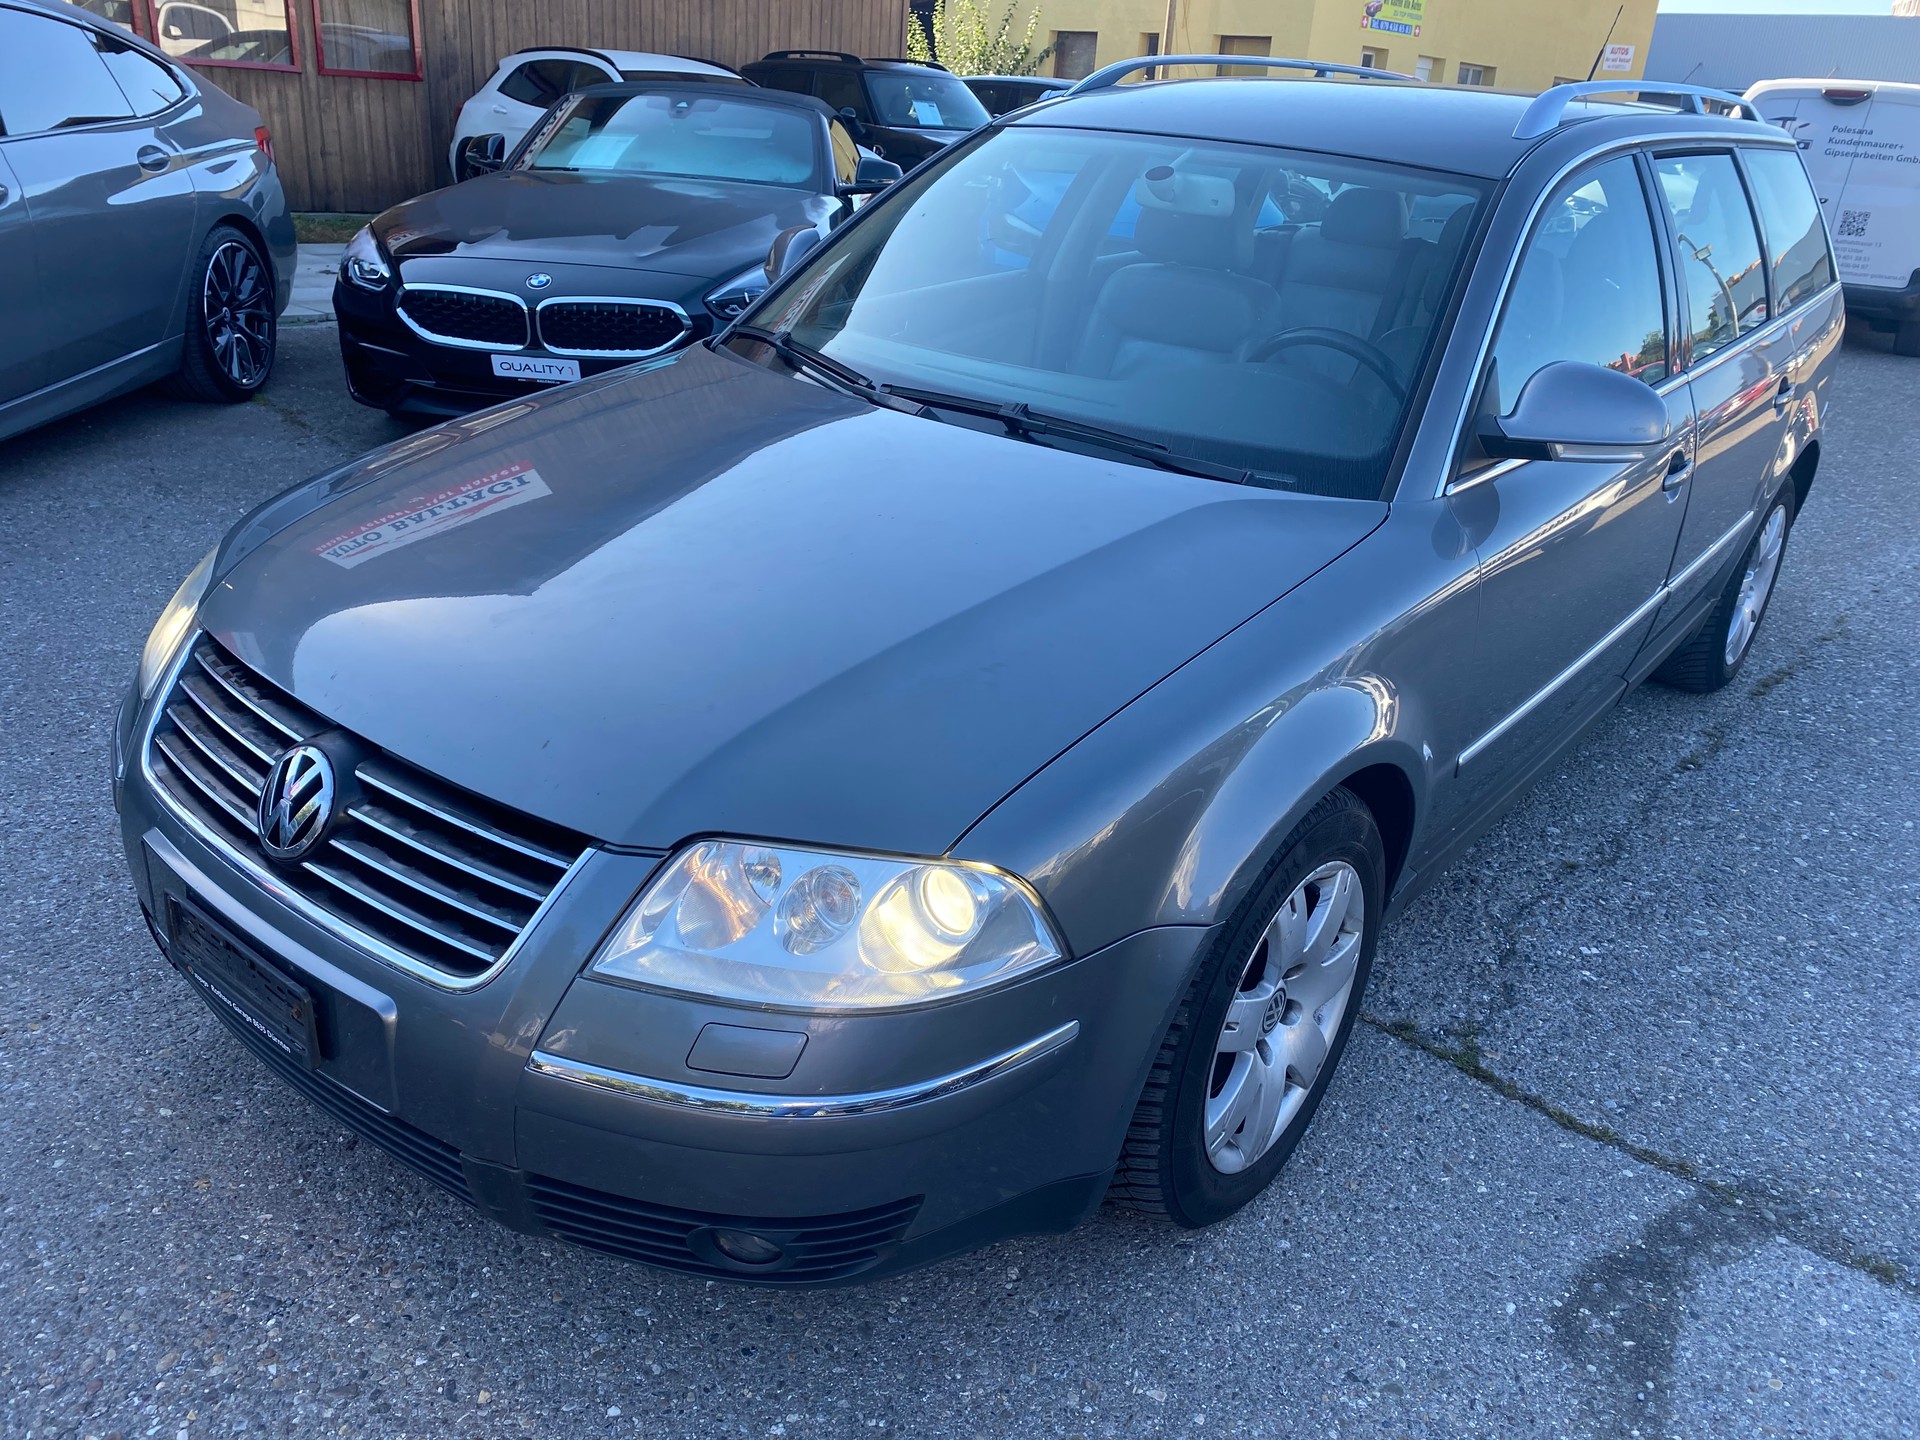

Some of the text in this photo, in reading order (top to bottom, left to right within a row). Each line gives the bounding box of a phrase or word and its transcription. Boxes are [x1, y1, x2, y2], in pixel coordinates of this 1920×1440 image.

[1610, 47, 1629, 56] AUTOS
[1832, 125, 1874, 136] Polesana
[1828, 136, 1906, 151] Kundenmaurer+
[1824, 148, 1895, 162] Gipserarbeiten
[500, 361, 565, 375] QUALITY
[233, 1002, 253, 1023] Garage
